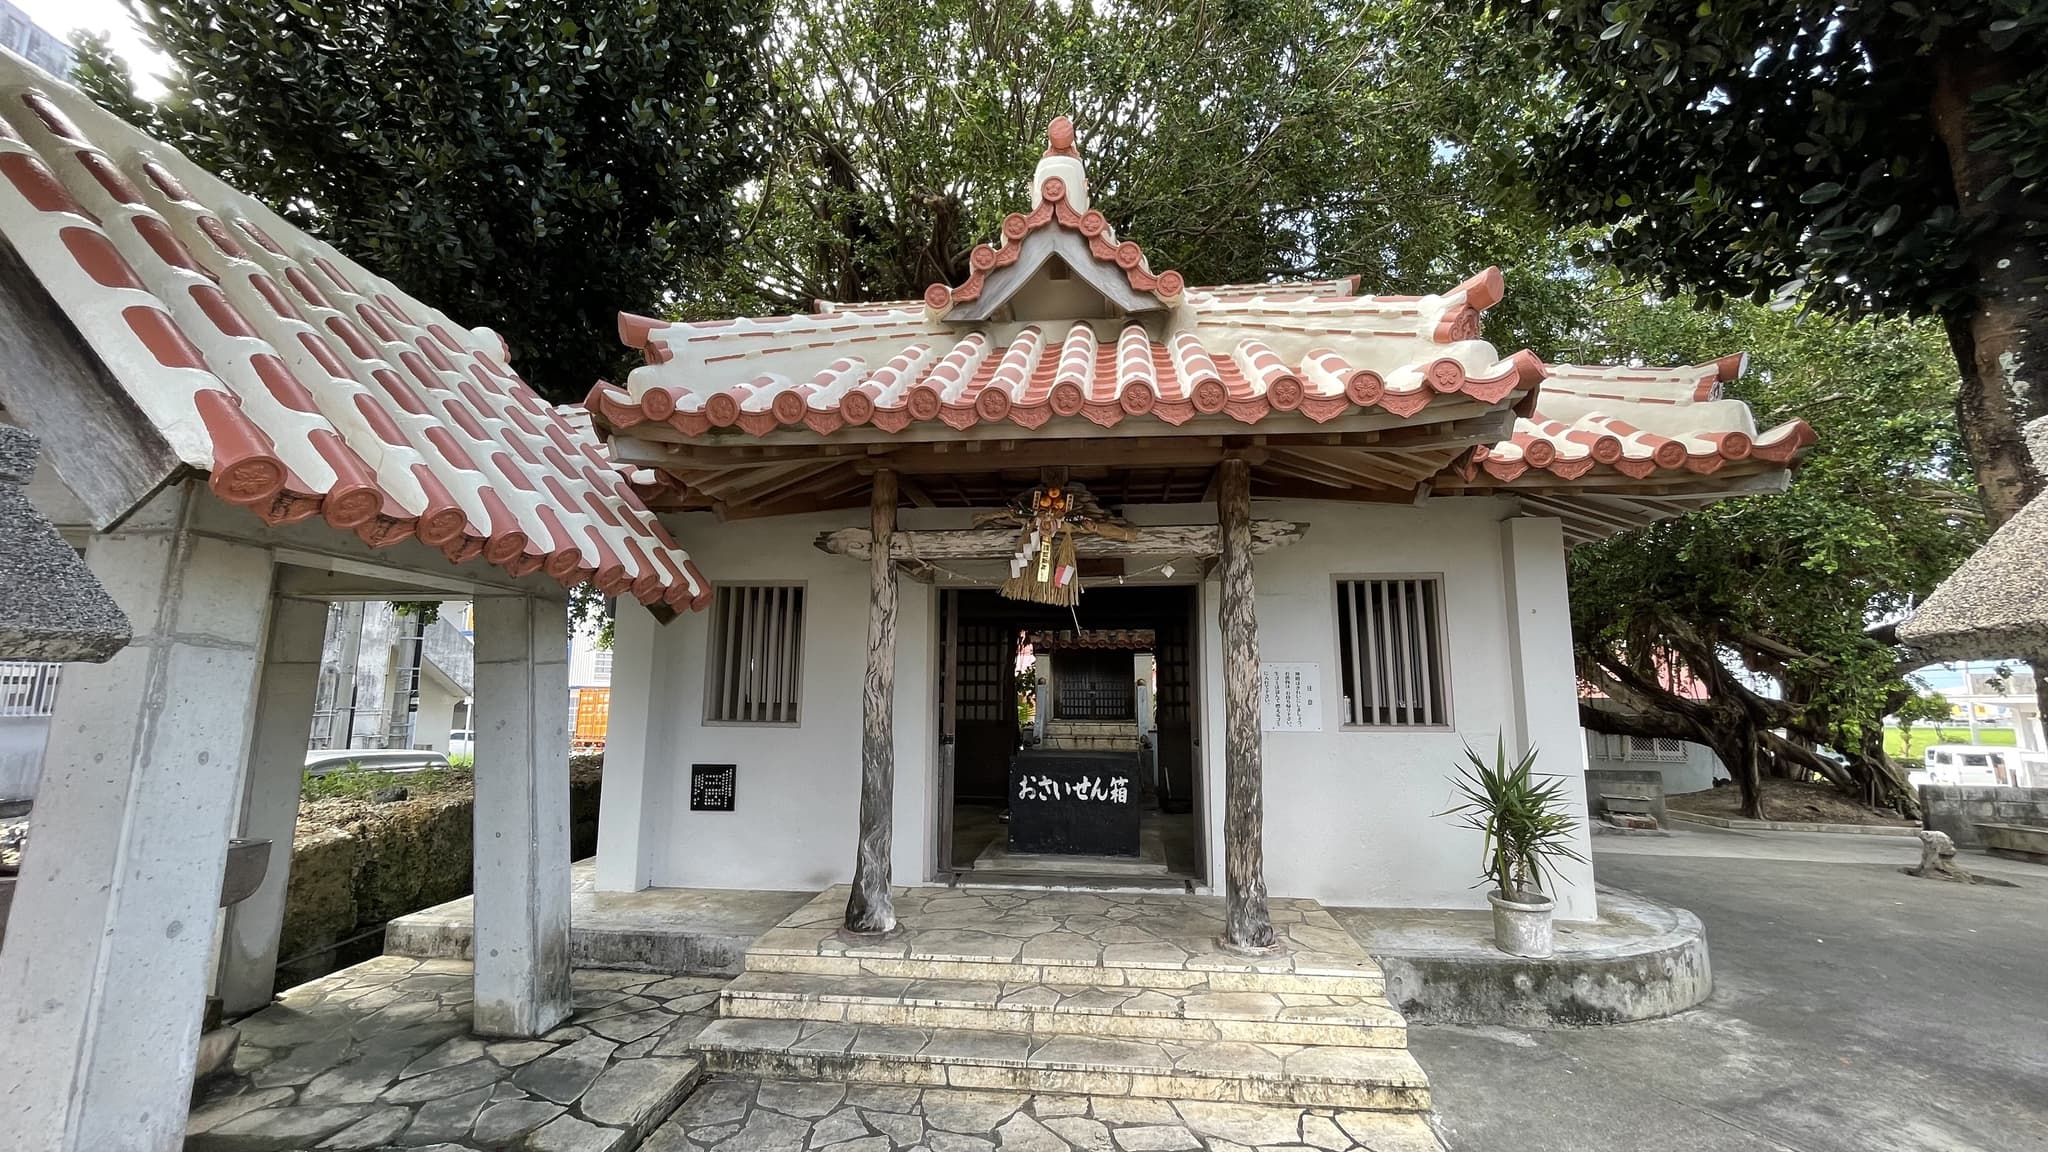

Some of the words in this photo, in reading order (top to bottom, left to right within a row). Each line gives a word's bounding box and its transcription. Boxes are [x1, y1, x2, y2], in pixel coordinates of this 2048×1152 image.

[1018, 774, 1129, 804] おさいせん箱
